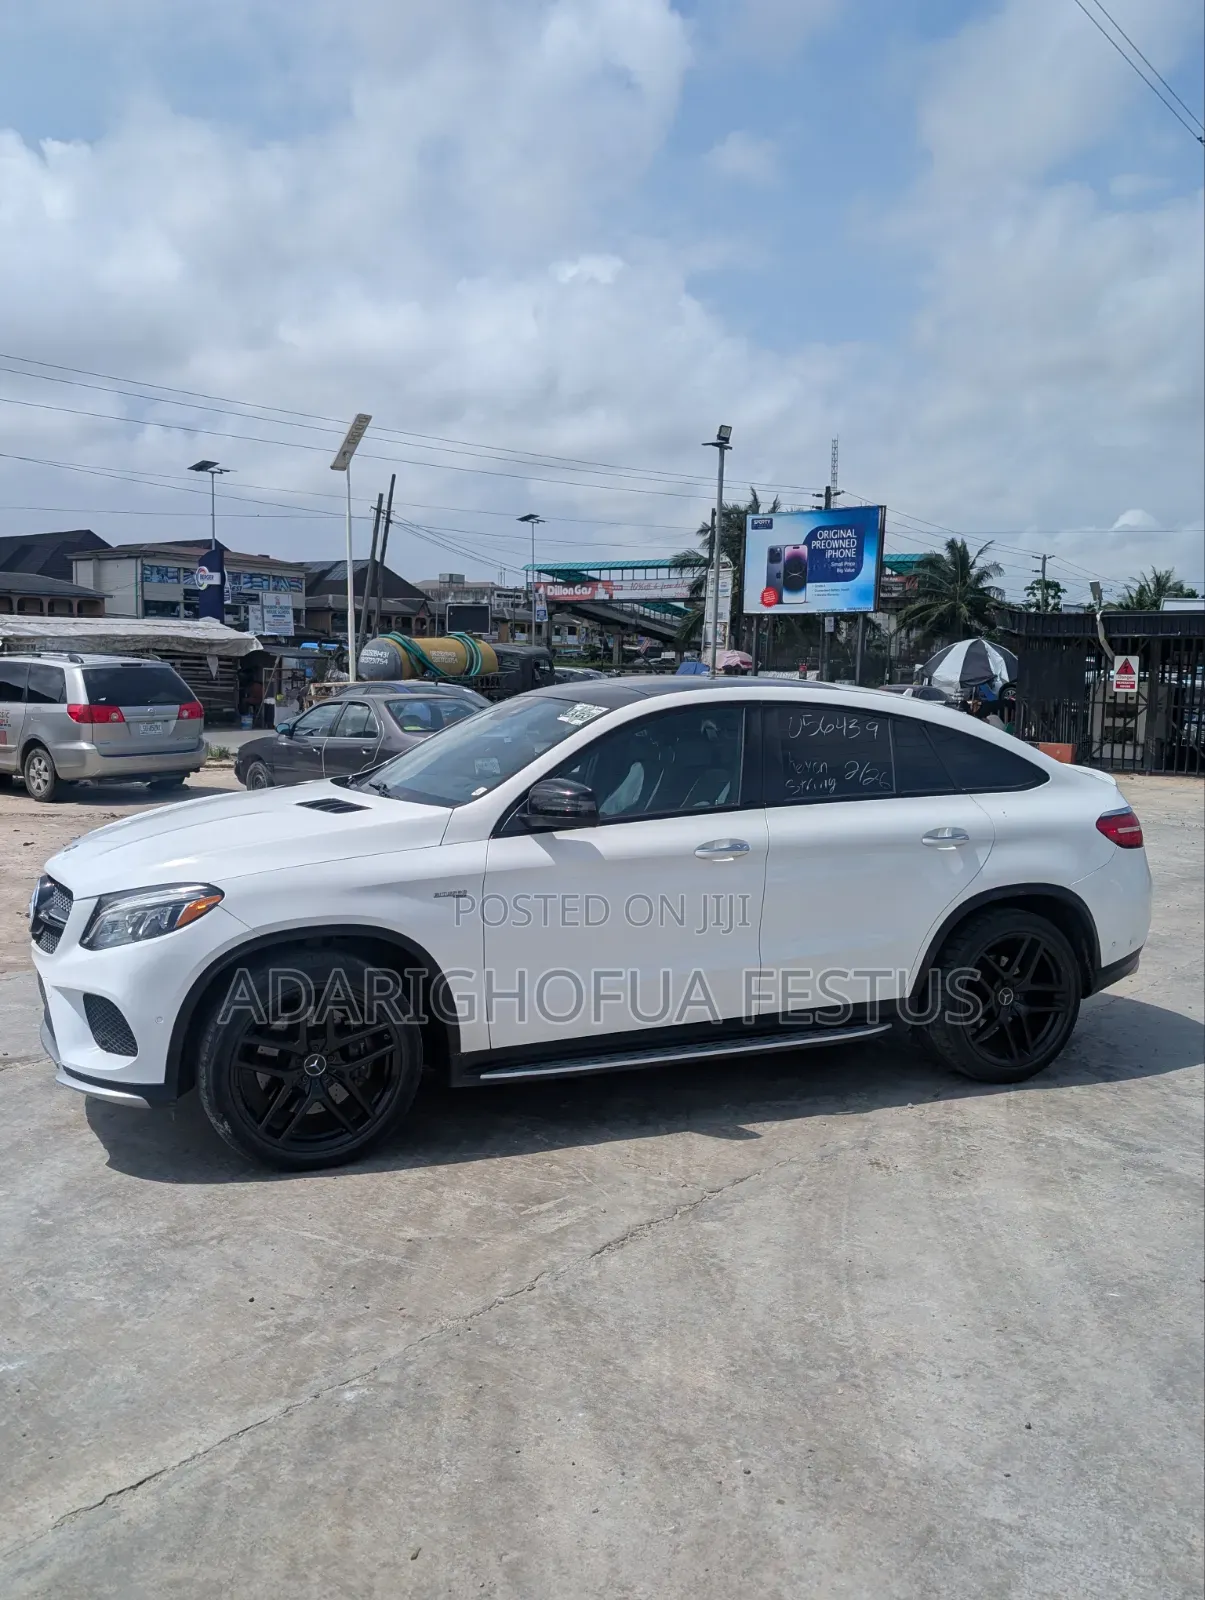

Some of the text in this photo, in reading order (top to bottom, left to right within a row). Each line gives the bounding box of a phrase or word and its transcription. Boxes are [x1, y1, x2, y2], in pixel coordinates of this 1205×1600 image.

[817, 529, 857, 540] ORIGINAL
[811, 539, 857, 550] PREOWNED
[825, 549, 857, 559] iPHONE
[547, 584, 573, 596] Dillon
